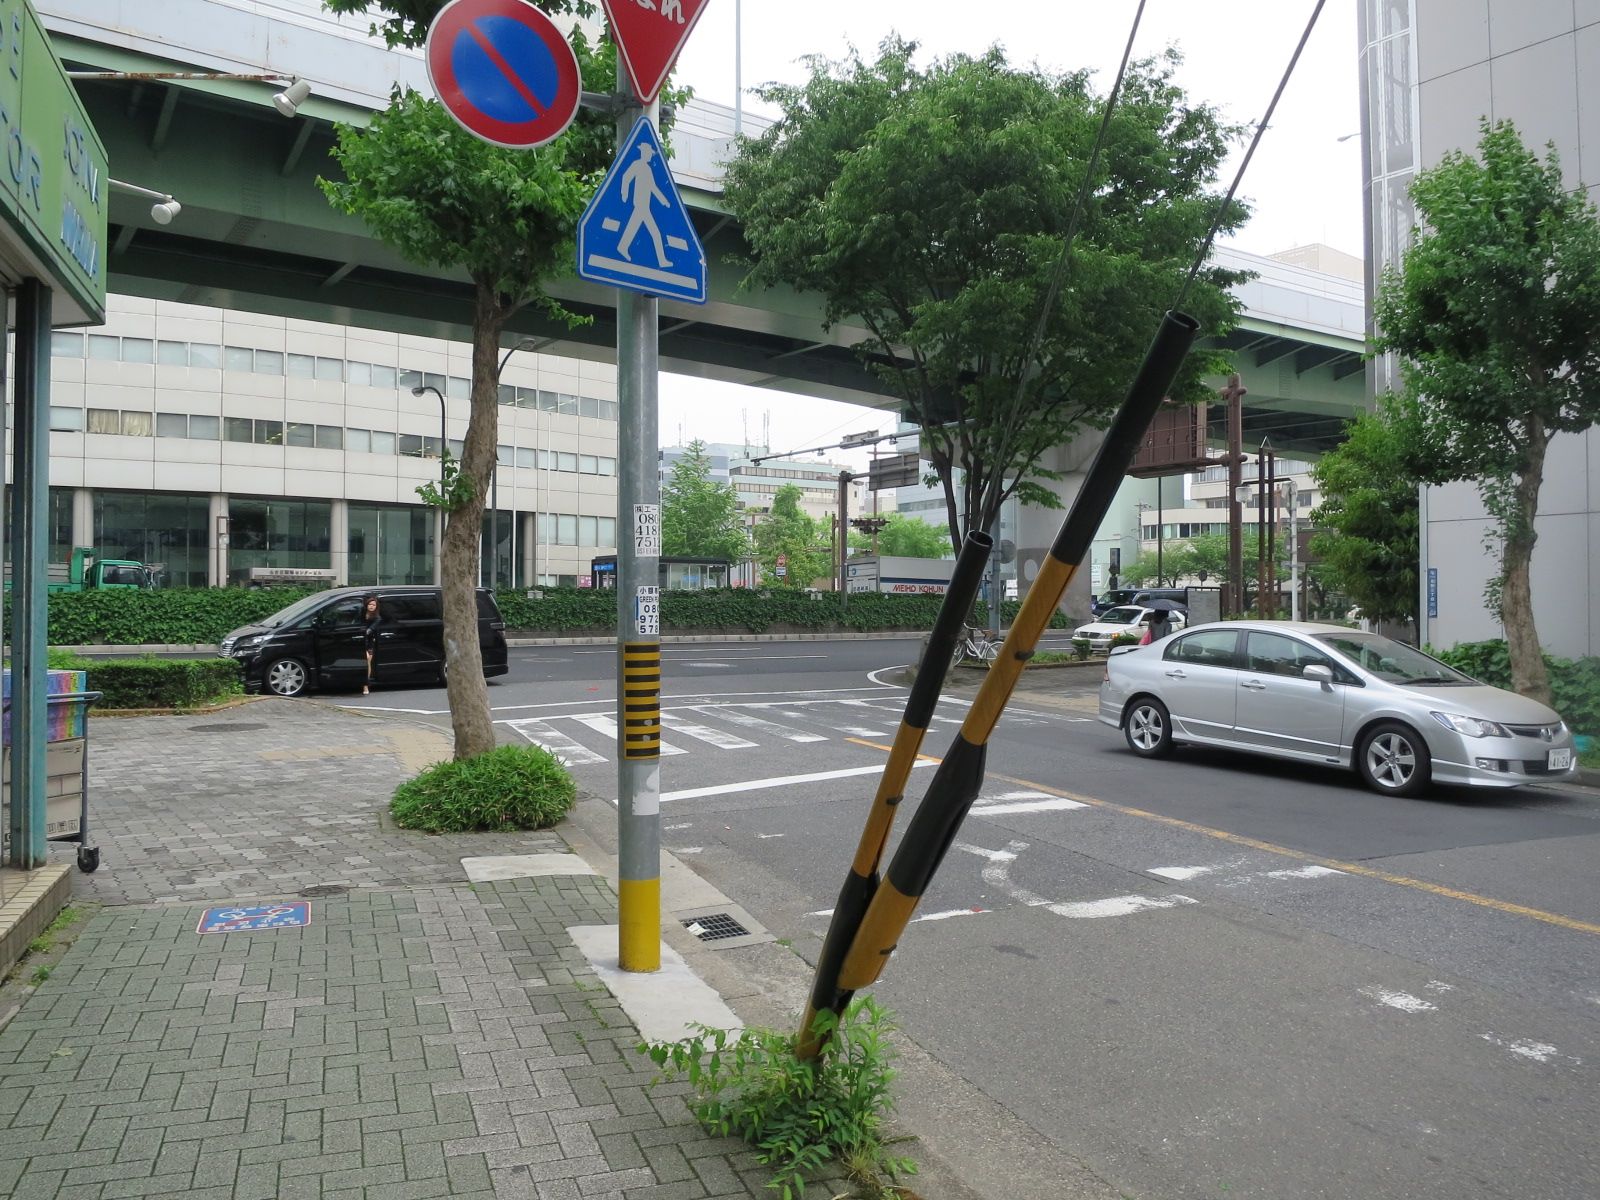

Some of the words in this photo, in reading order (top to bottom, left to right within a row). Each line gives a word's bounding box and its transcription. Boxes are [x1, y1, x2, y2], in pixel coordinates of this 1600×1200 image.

[635, 525, 658, 536] 418
[635, 536, 659, 547] 751
[892, 584, 917, 593] MEIHO
[639, 614, 658, 623] 972
[639, 625, 658, 634] 578
